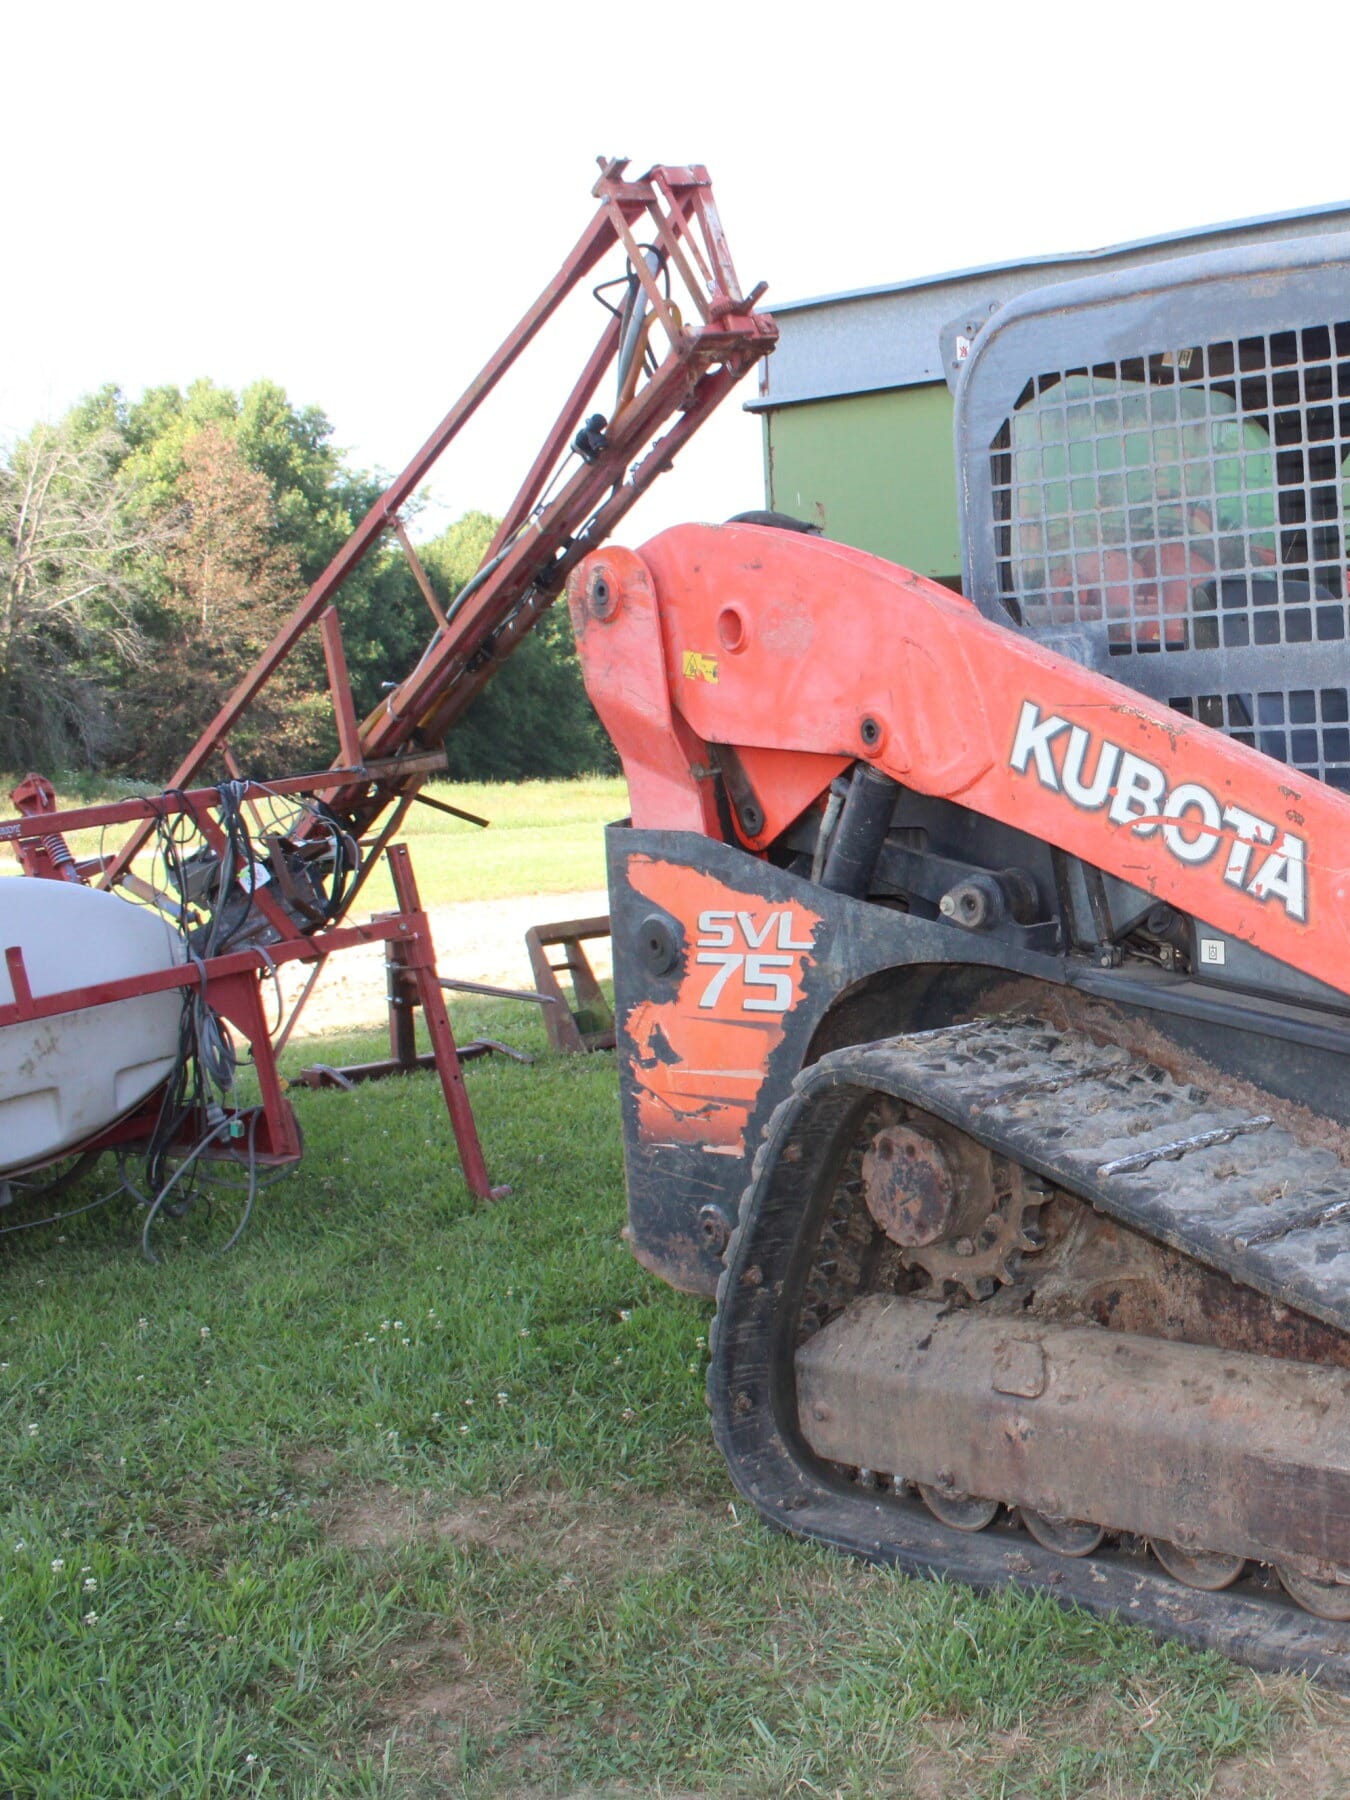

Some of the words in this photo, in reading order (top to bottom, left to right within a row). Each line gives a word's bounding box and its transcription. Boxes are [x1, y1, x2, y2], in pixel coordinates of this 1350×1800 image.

[1009, 700, 1307, 922] KUBOTA
[697, 910, 817, 949] SVL
[696, 952, 794, 1012] 75
